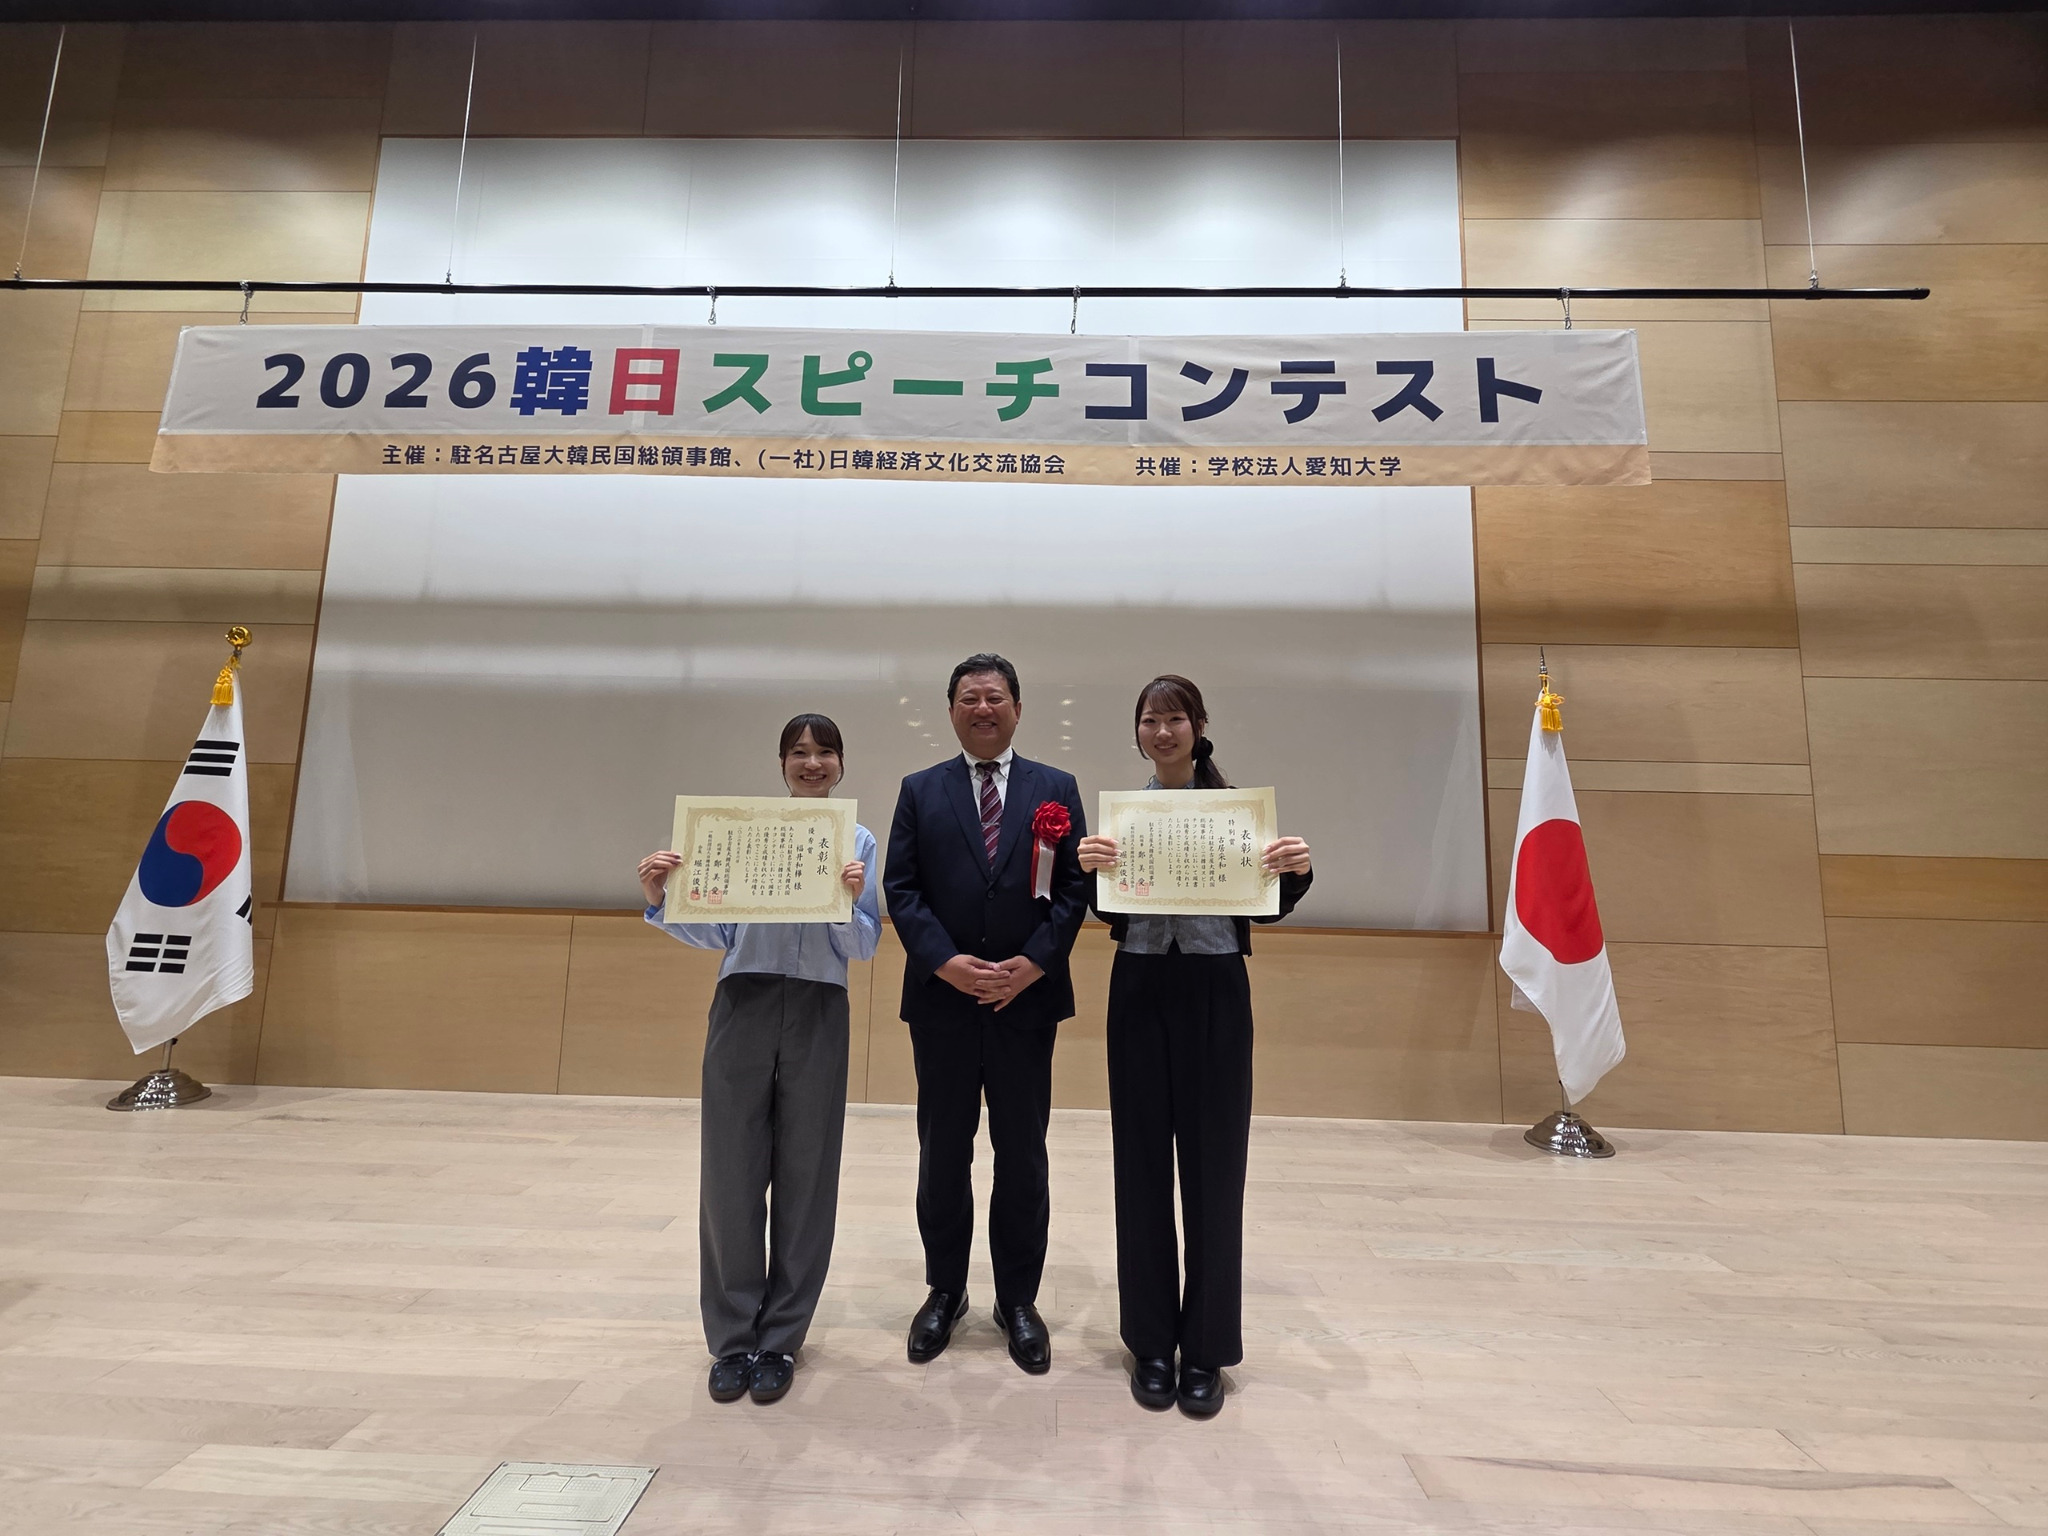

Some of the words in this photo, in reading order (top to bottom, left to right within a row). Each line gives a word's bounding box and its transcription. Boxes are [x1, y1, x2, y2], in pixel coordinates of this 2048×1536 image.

[255, 346, 1543, 423] 2026韓日スピーチコンテスト
[806, 827, 815, 855] 優秀賞
[1228, 819, 1236, 846] 特別賞
[1240, 829, 1253, 868] 表彰状
[816, 838, 830, 876] 表彰状
